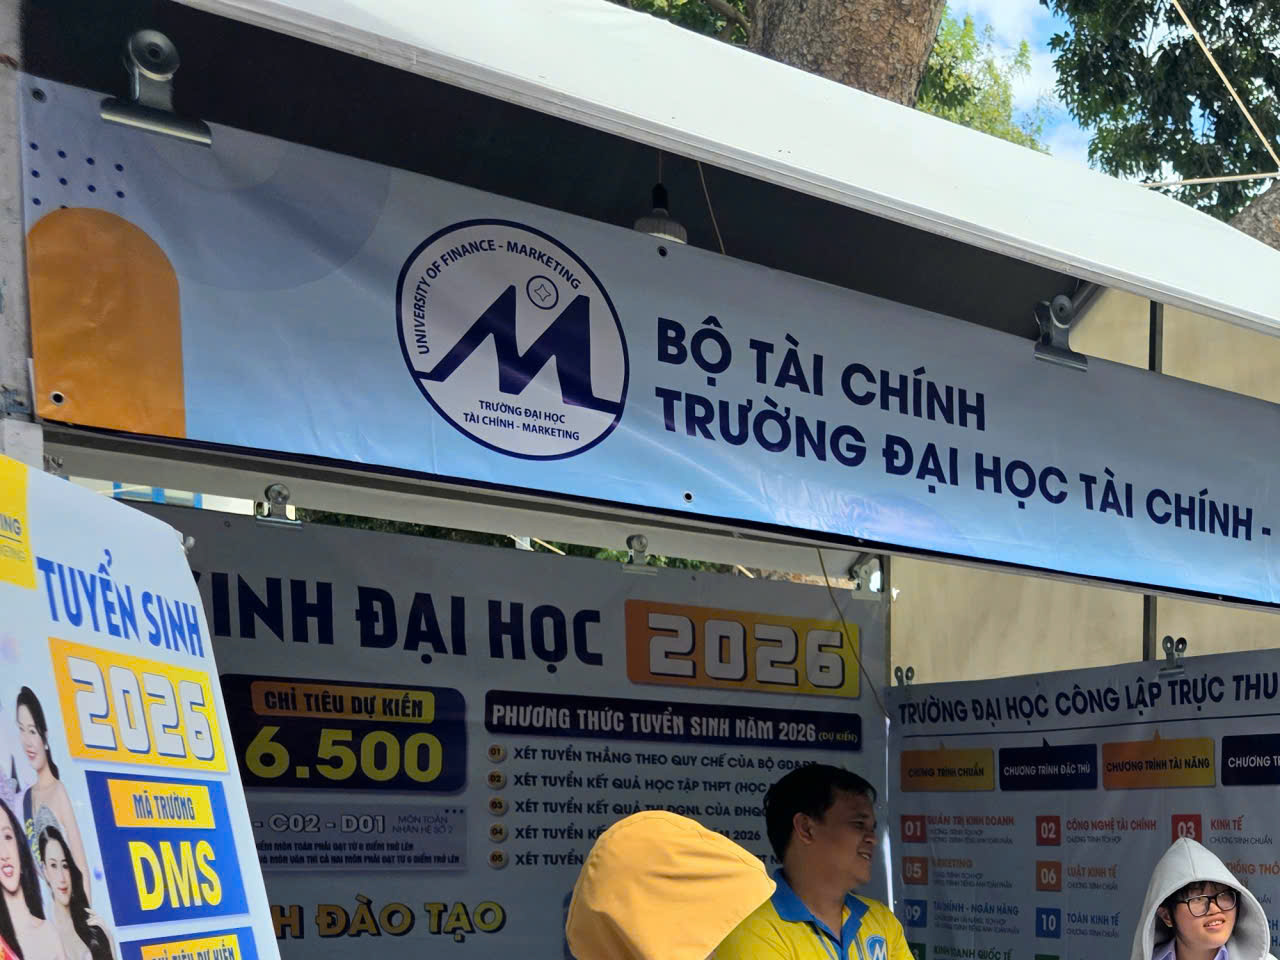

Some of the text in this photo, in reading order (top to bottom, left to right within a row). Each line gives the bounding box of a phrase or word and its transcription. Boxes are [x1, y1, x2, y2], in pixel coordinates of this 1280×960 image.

[412, 239, 582, 356] UNIVERSITY OF FINANCE MARKETING
[657, 315, 986, 431] BỘ TÀI CHÍNH
[463, 411, 580, 441] TÀI CHÍNH MARKETING
[478, 399, 566, 426] TRƯỜNG ĐẠI HỌC
[655, 387, 867, 467] TRƯỜNG
[883, 434, 959, 494] ĐẠI
[975, 452, 1068, 509] HỌC
[1079, 467, 1133, 519] TÀI
[1146, 488, 1253, 542] CHÍNH
[36, 548, 205, 658] TUYỂN SINH
[355, 585, 845, 690] ĐẠI HỌC 2026
[67, 656, 216, 761] 2026
[264, 689, 424, 719] CHỈ TIÊU DỰ KIẾN
[492, 704, 817, 742] PHƯƠNG THỨC TUYỂN SINH NĂM 2026
[898, 695, 969, 725] TRƯỜNG
[973, 699, 1001, 729] ĐẠI
[1008, 694, 1050, 726] HỌC
[1055, 683, 1120, 717] CÔNG
[1125, 676, 1162, 716] LẬP
[1167, 673, 1225, 711] TRỰC
[245, 726, 443, 783] 6.500
[513, 744, 775, 773] XÉT TUYỂN THẲNG THEO QUY CHẾ CỦA BỘ
[1227, 753, 1272, 768] CHƯƠNG
[132, 793, 196, 821] MÃ TRƯỜNG
[128, 840, 222, 911] DMS
[315, 893, 507, 943] ĐÀO TẠO
